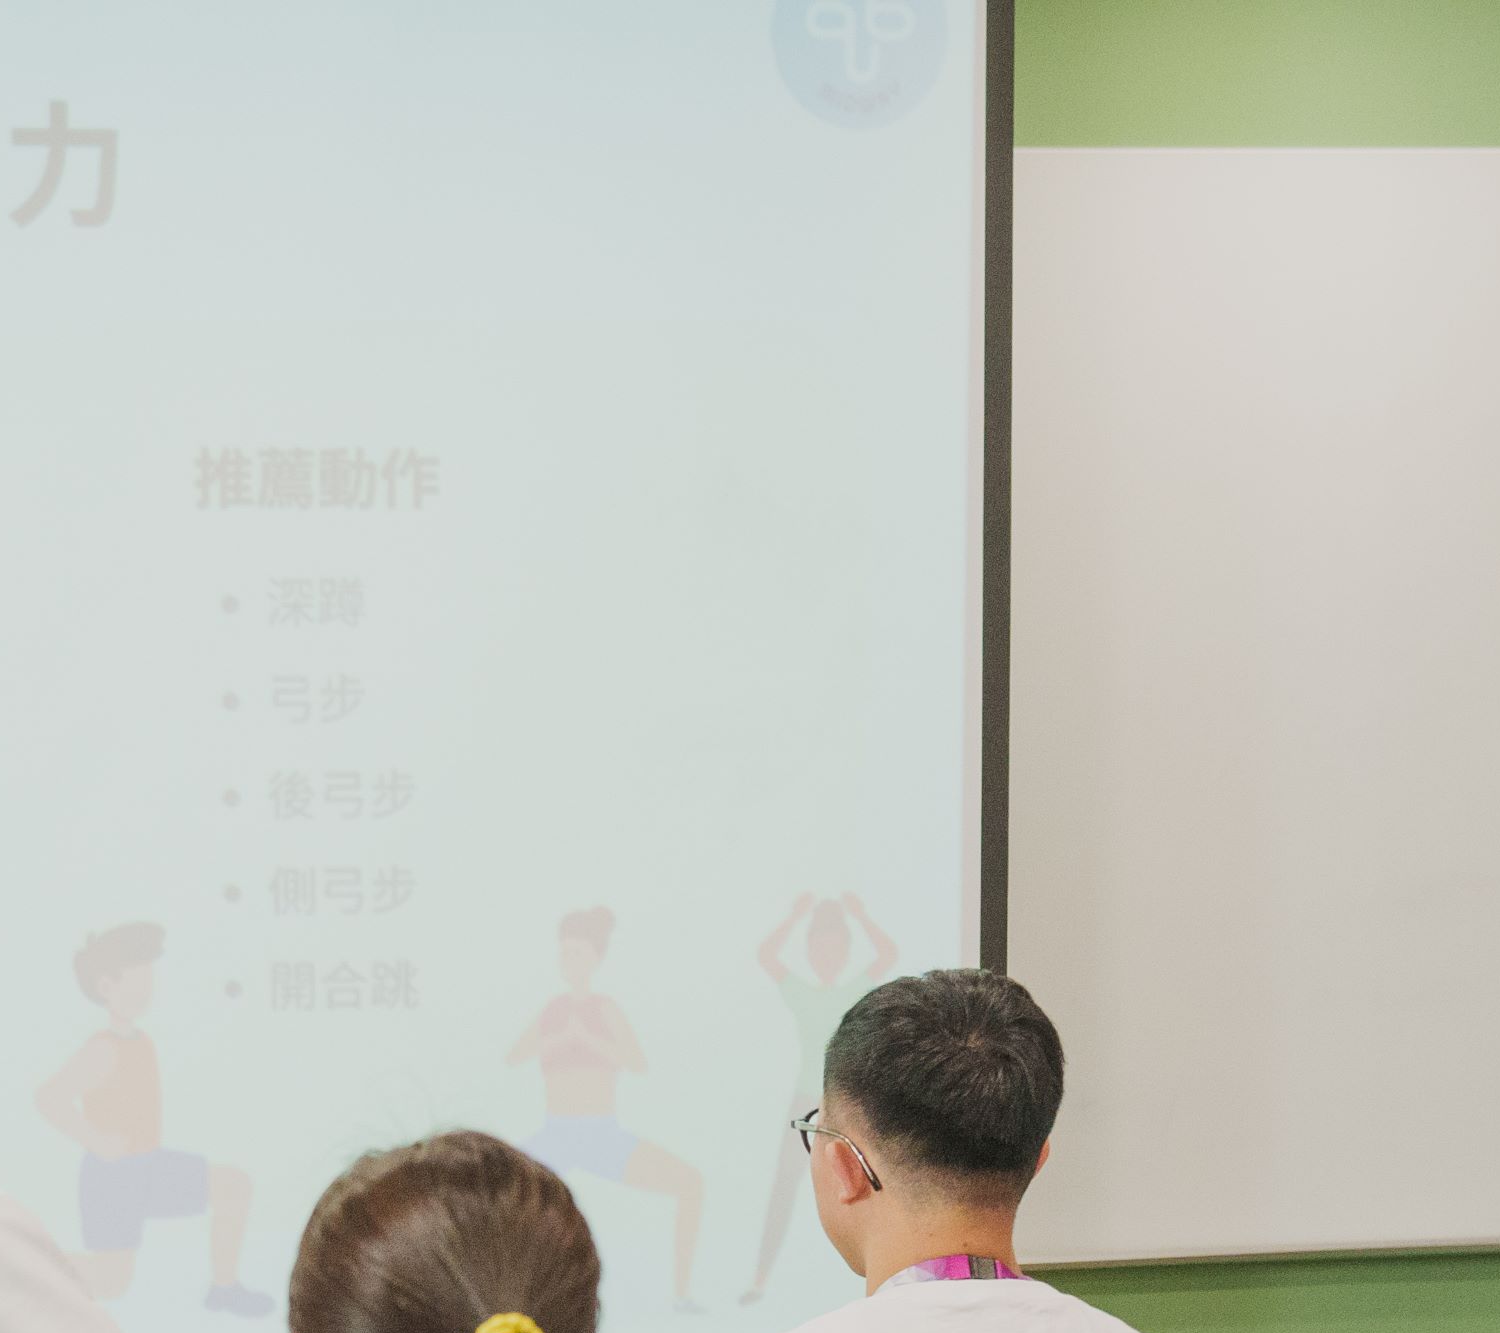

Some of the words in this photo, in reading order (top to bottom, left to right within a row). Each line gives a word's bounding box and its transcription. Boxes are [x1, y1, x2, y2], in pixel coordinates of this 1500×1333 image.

[194, 446, 440, 510] 推薦動作
[267, 577, 366, 626] 深蹲
[272, 673, 366, 724] 弓步
[268, 769, 416, 820] 後弓步
[268, 864, 418, 916] 側弓步
[270, 959, 420, 1012] 開合跳
